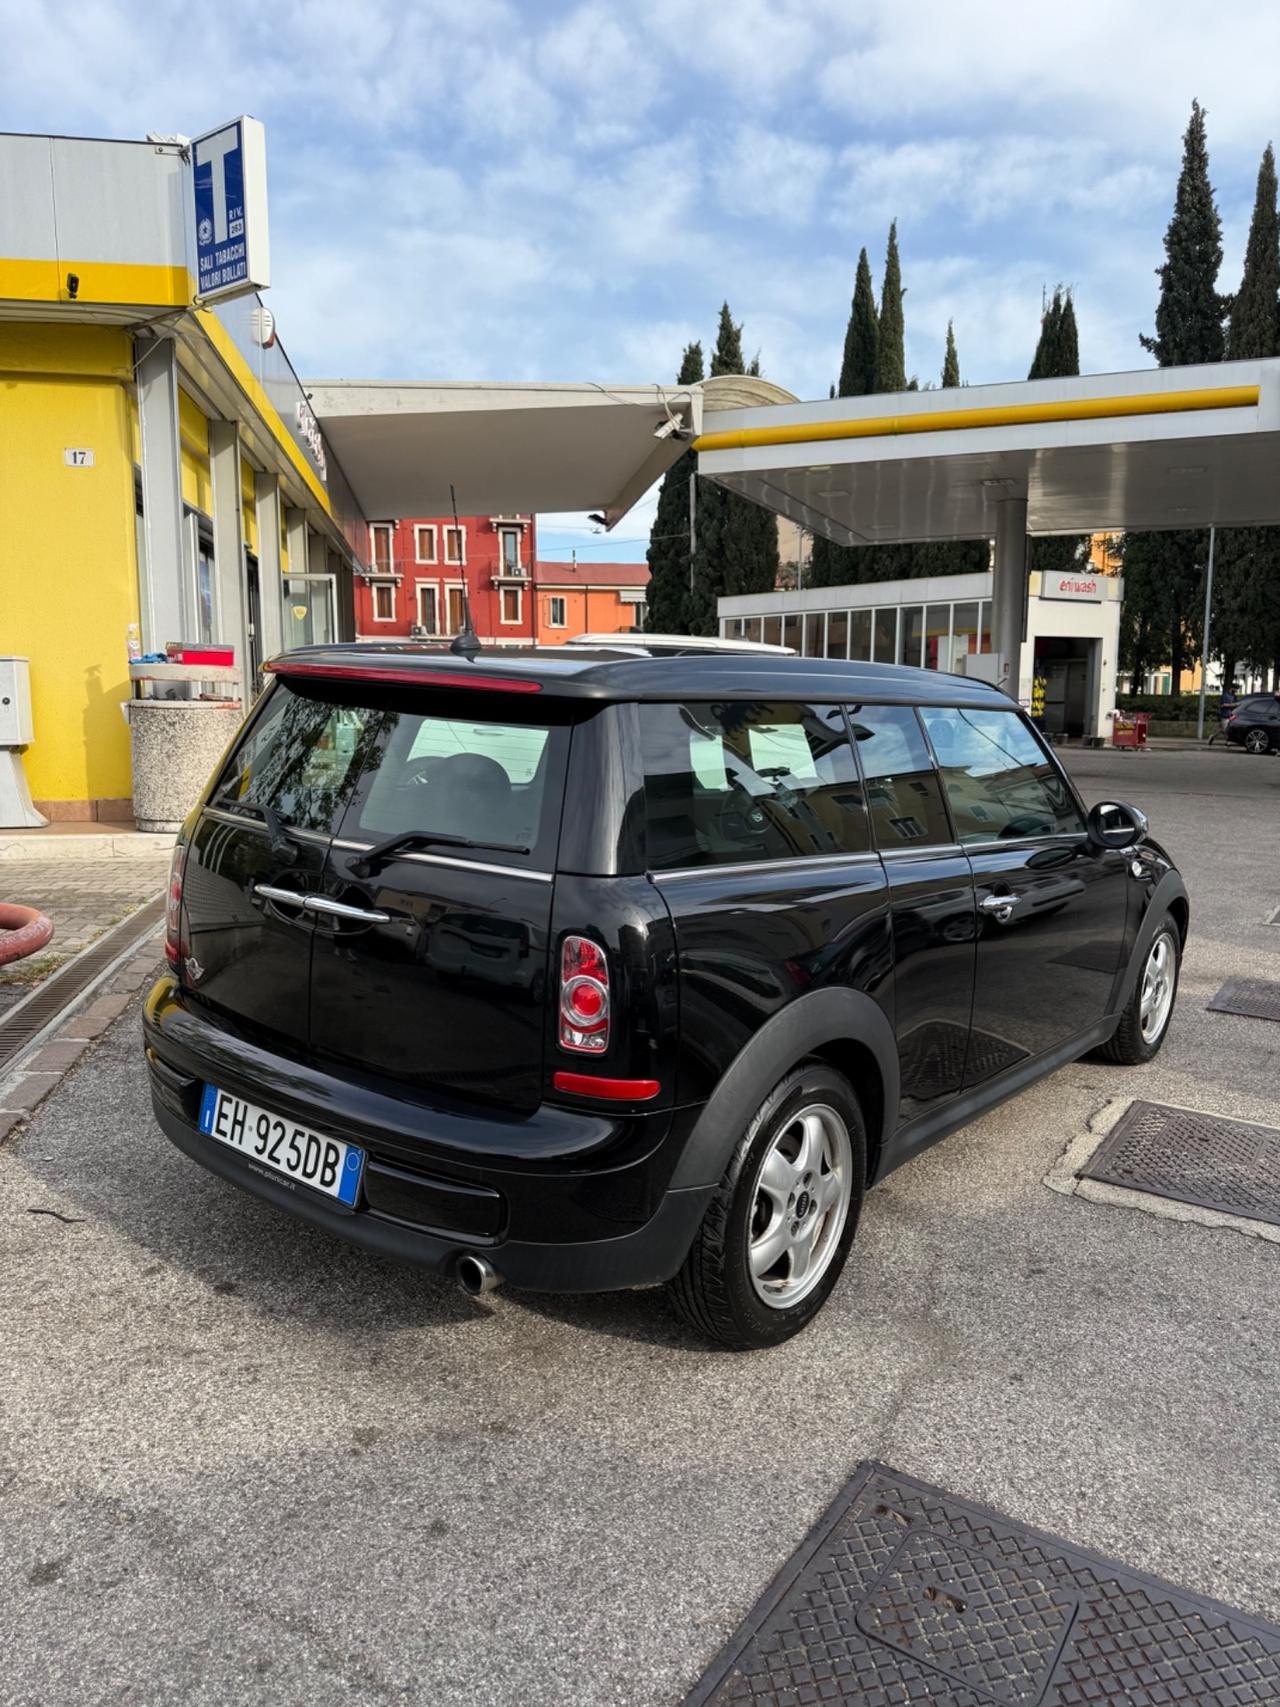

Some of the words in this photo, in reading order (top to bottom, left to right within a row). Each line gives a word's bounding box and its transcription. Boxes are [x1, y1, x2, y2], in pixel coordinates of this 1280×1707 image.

[196, 125, 239, 244] T
[200, 254, 214, 272] SALI
[215, 242, 245, 267] TABACCHI
[200, 270, 221, 291] VALORI
[222, 262, 247, 283] BOLLATI
[73, 451, 86, 464] 17
[215, 1094, 248, 1145] EH
[254, 1113, 341, 1188] 925DB
